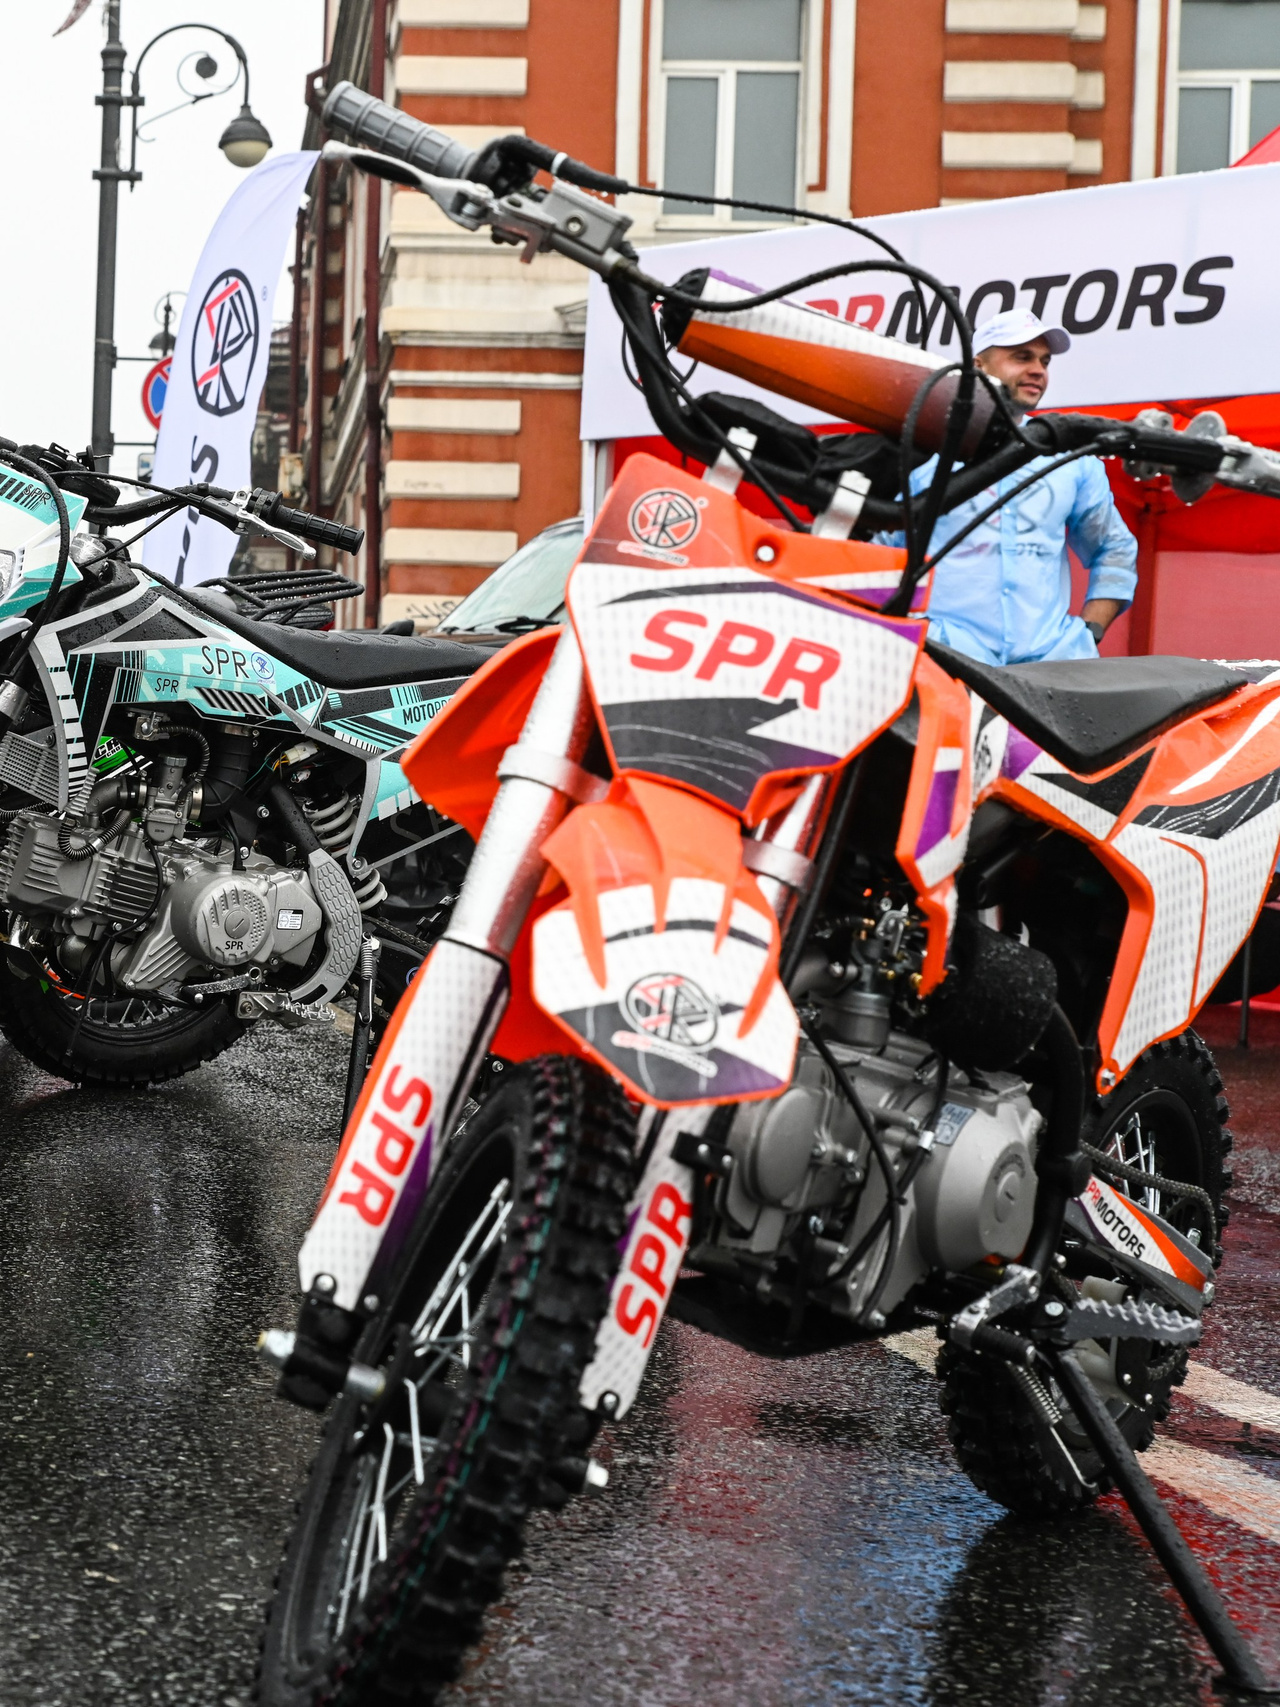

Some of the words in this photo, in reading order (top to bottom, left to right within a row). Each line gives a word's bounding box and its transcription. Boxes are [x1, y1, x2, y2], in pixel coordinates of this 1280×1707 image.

[154, 677, 179, 694] SPR
[201, 645, 250, 679] SPR
[630, 609, 842, 711] SPR
[224, 940, 244, 950] SPR
[338, 1063, 434, 1227] SPR
[1085, 1174, 1146, 1260] PRMOTORS
[614, 1182, 692, 1349] SPR
